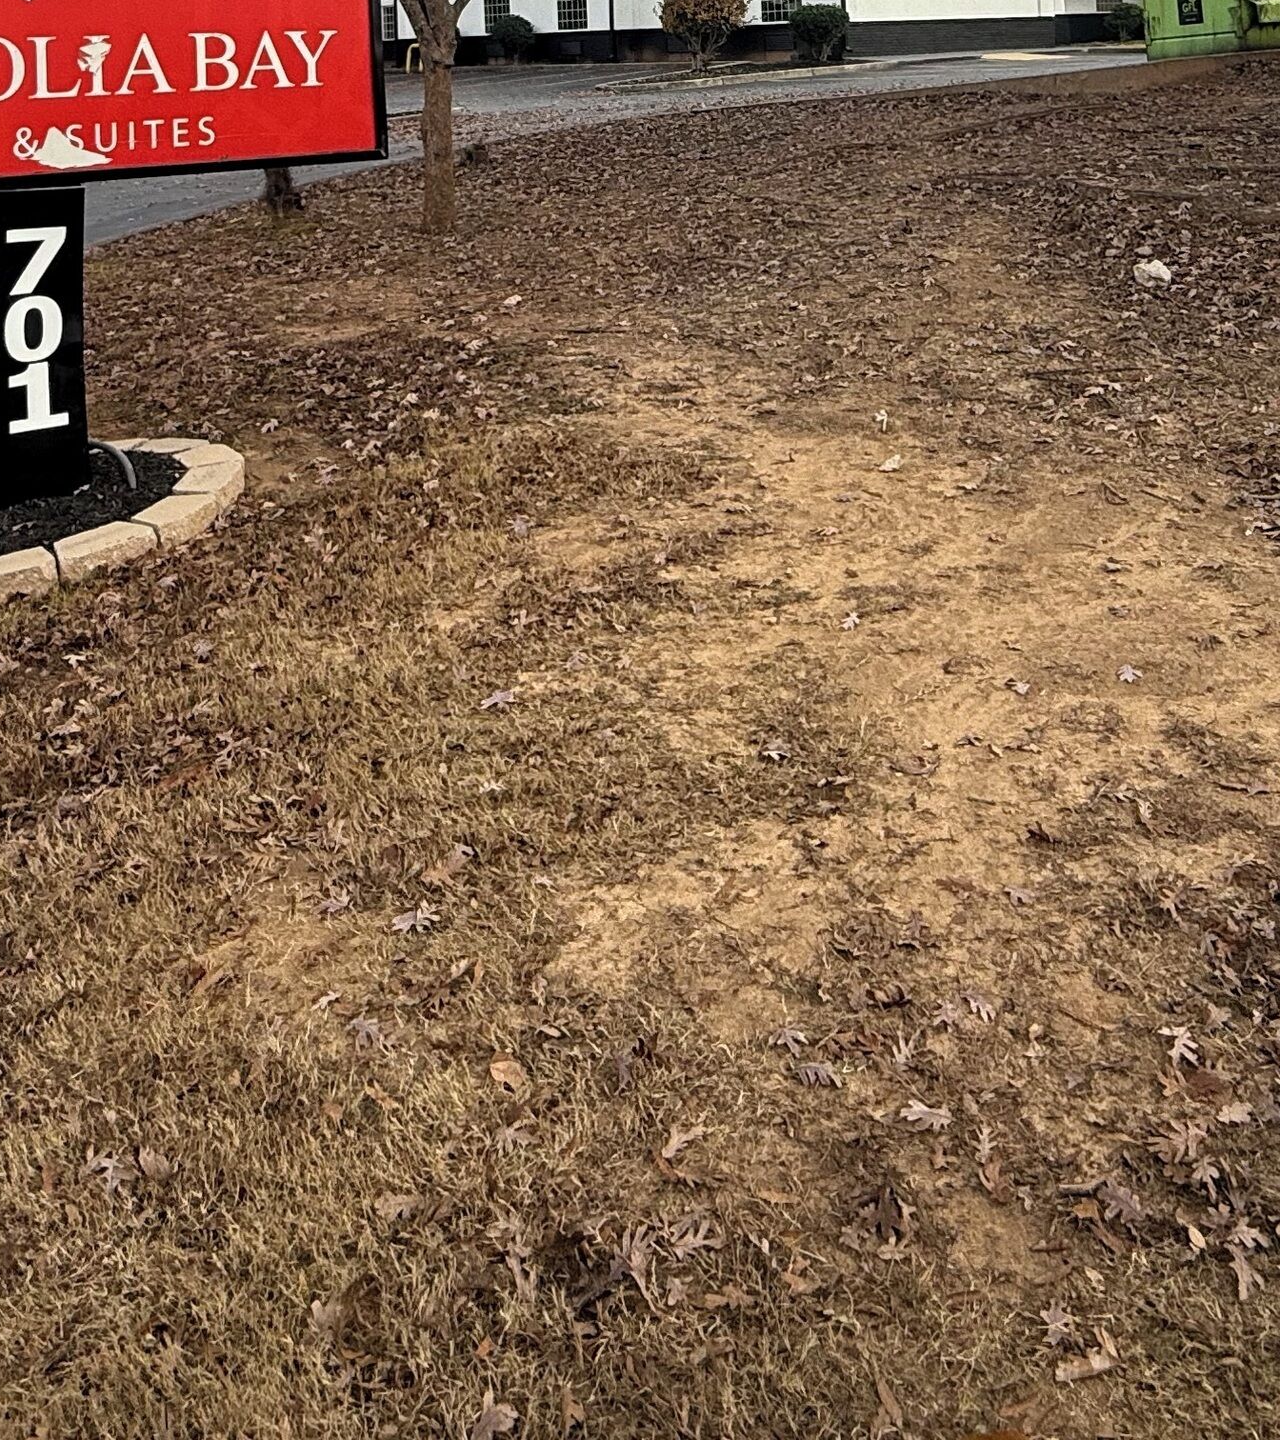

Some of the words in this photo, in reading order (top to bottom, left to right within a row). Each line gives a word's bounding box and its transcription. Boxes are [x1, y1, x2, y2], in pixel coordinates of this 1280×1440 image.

[189, 30, 338, 92] BAY
[12, 126, 39, 161] &
[65, 116, 217, 154] SUITES
[4, 226, 70, 435] 701
